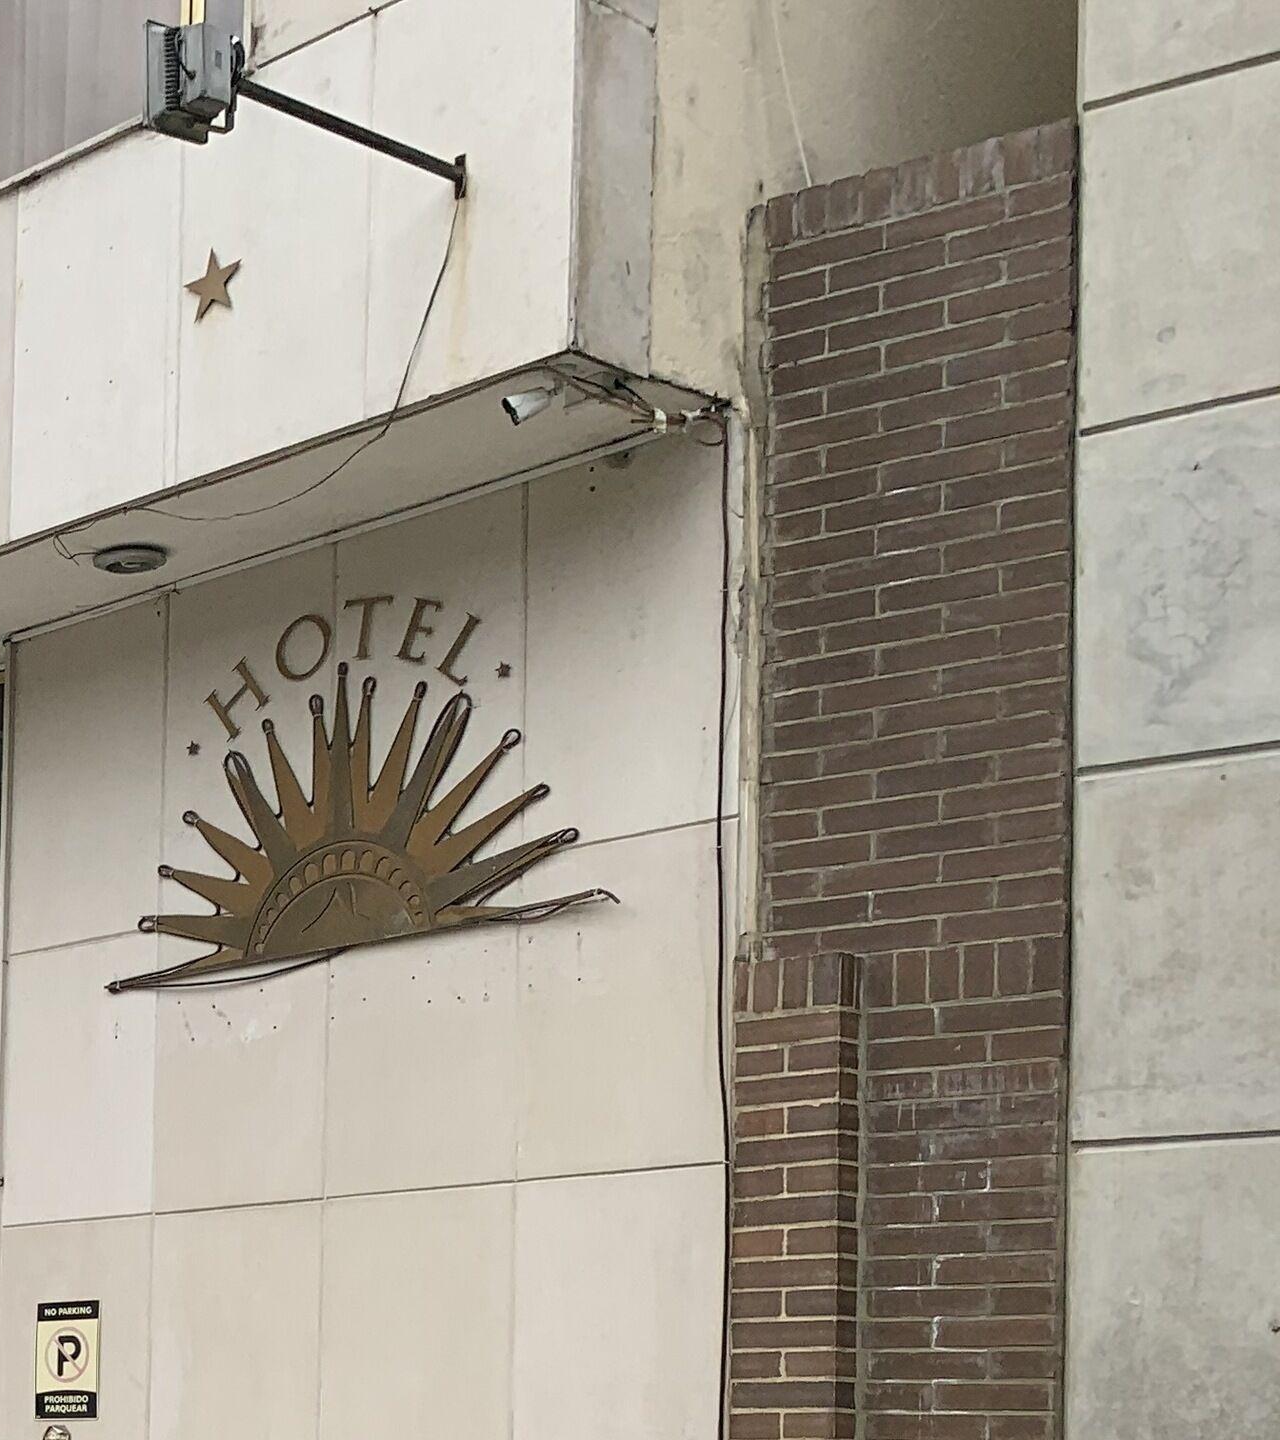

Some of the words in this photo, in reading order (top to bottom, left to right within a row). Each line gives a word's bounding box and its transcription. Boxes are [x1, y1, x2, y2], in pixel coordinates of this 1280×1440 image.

[204, 594, 482, 742] HOTEL
[44, 1308, 57, 1317] NO
[58, 1305, 92, 1315] PARKING
[44, 1395, 89, 1404] PROHIBIDO
[45, 1404, 88, 1413] PARQUEAR
